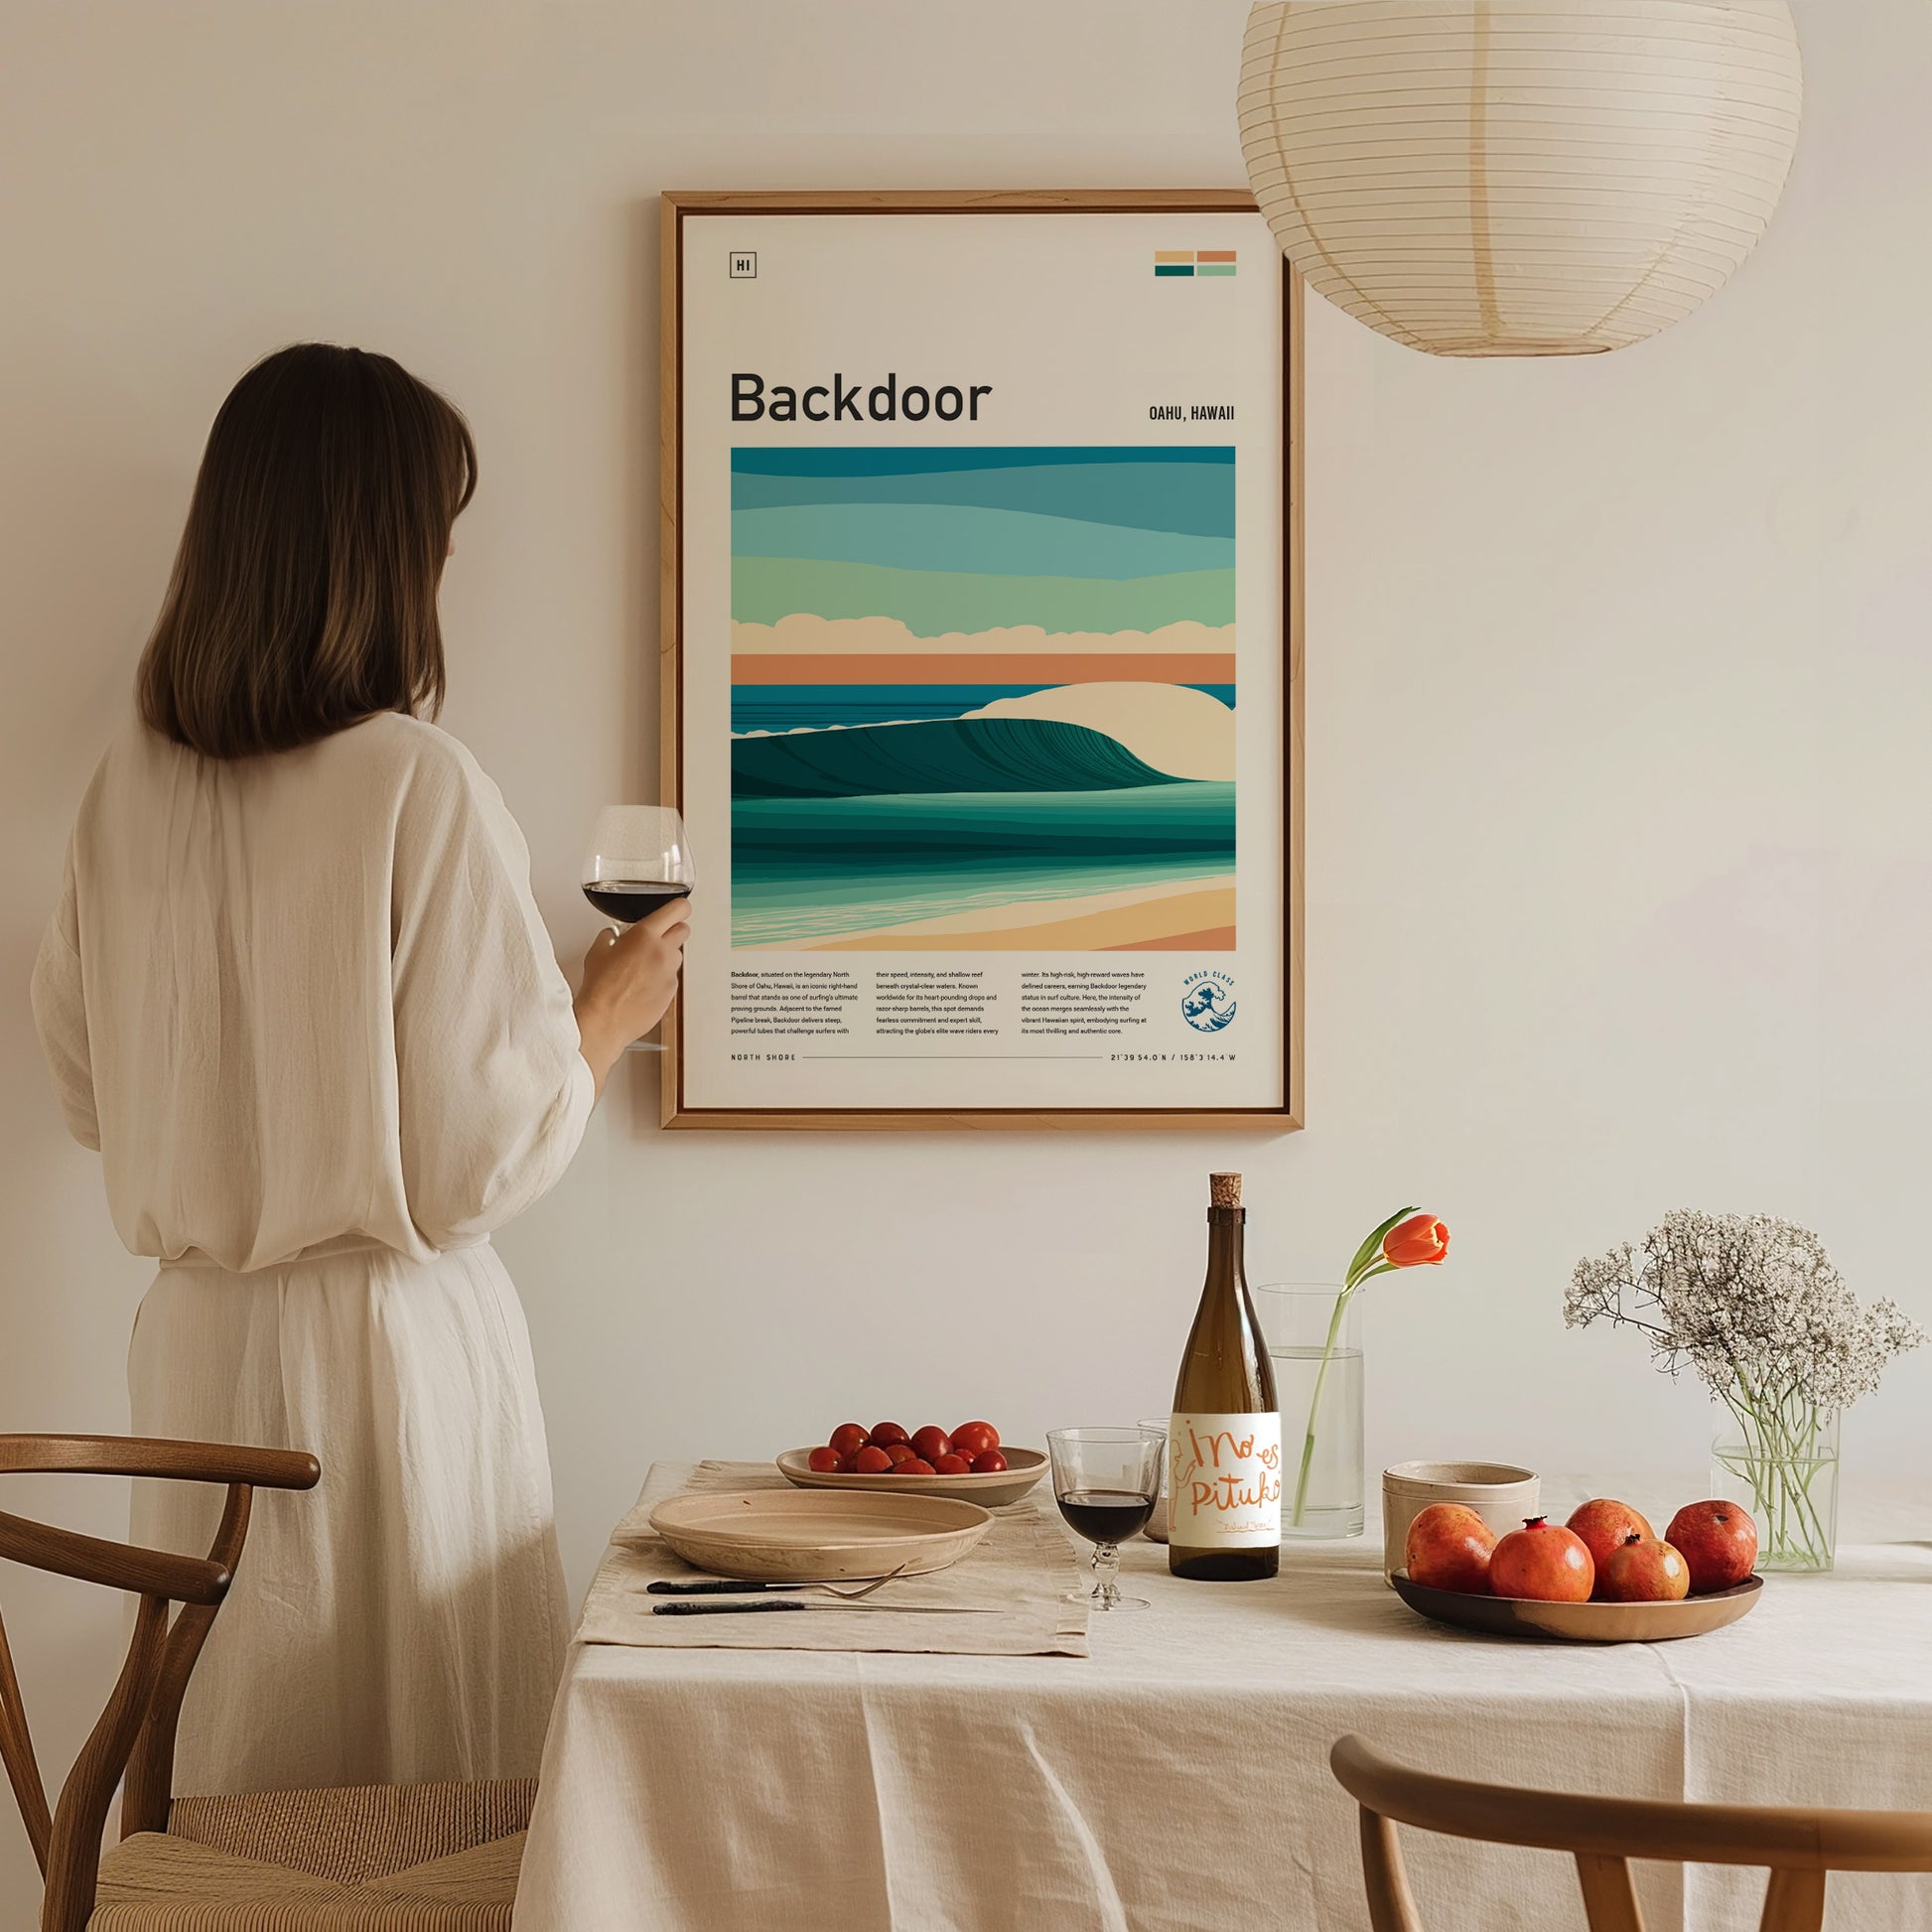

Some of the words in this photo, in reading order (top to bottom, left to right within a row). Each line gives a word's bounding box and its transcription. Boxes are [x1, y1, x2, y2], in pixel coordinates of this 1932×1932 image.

[737, 259, 751, 271] HI
[731, 372, 993, 421] Backdoor
[1149, 405, 1186, 422] OAHU,
[1190, 405, 1235, 421] HAWAII
[1183, 970, 1207, 986] WORLD
[1212, 971, 1235, 986] CLASS
[1067, 982, 1090, 991] earning
[1119, 982, 1148, 991] legendary
[968, 993, 985, 1002] drops
[1109, 993, 1134, 1002] intensity
[731, 1027, 757, 1035] powerful
[787, 1027, 814, 1035] challenge
[877, 1027, 903, 1035] attracting
[1045, 1027, 1067, 1035] thrilling
